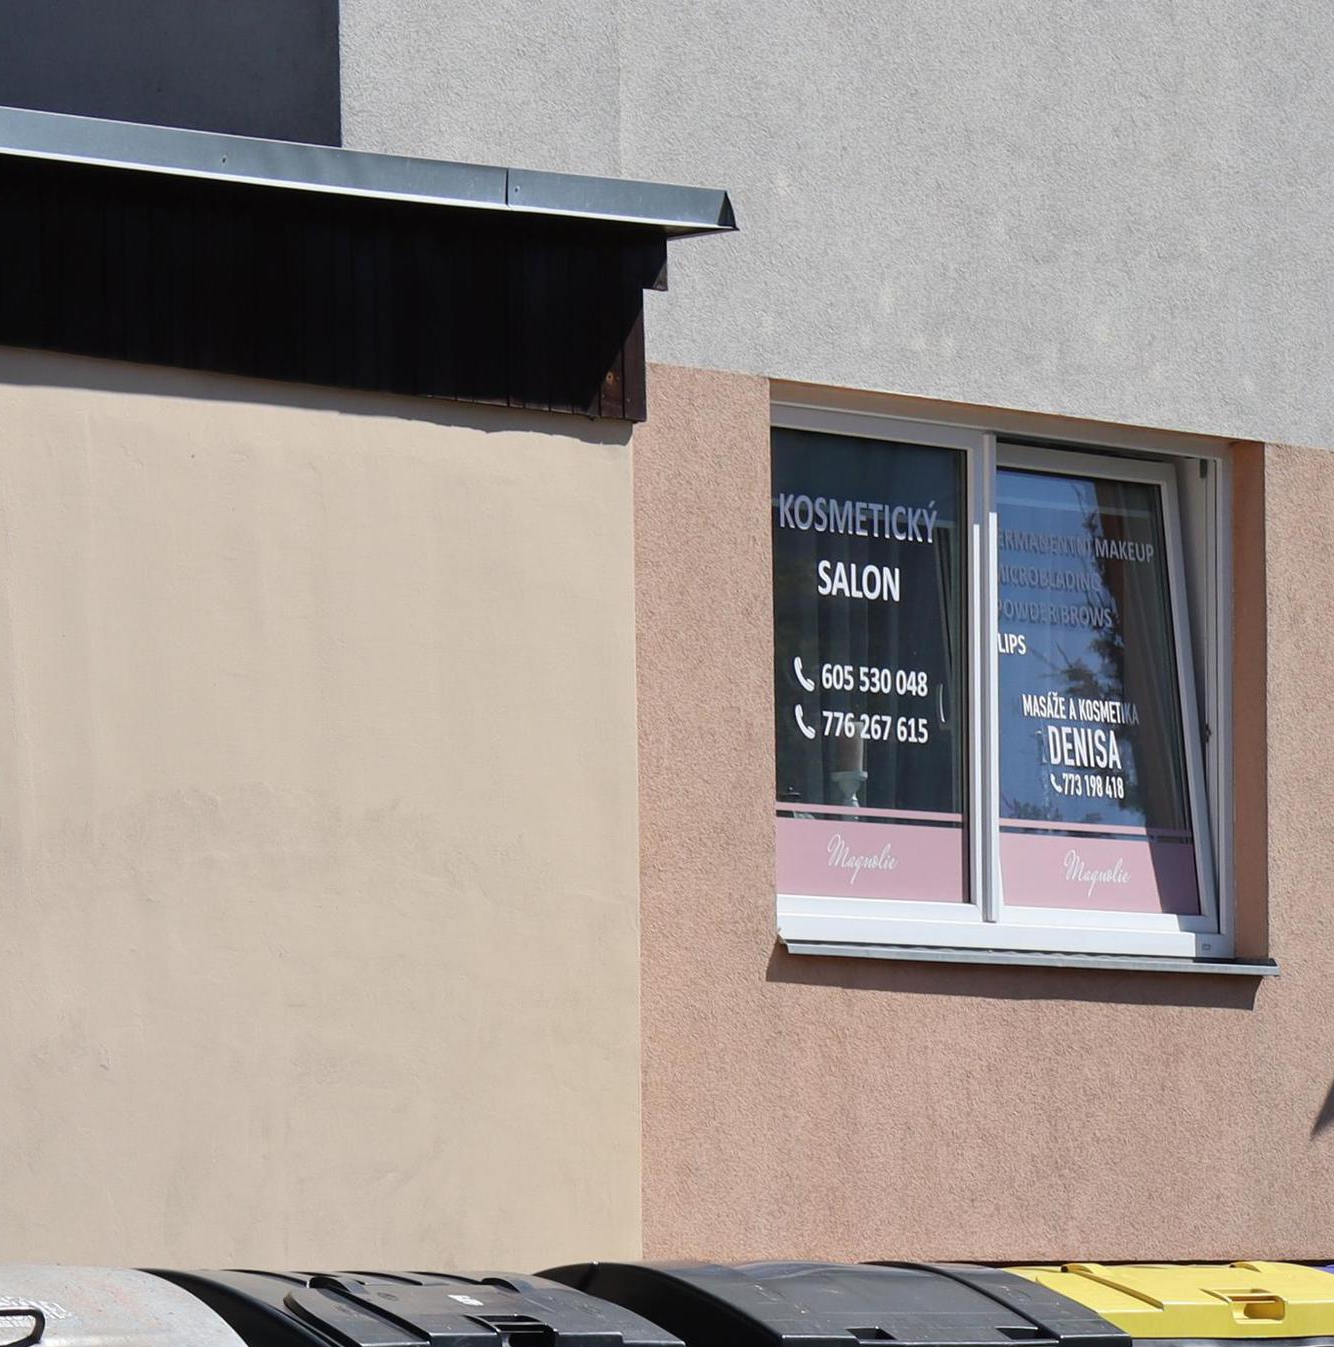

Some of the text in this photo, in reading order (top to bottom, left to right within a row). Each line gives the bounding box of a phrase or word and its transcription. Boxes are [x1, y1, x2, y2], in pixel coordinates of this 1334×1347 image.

[778, 492, 937, 544] KOSMETICKÝ
[1094, 538, 1154, 563] MAKEUP
[817, 559, 900, 602] SALON
[998, 633, 1027, 655] LIPS
[821, 663, 928, 697] 605 530 048
[1022, 691, 1140, 725] MASÁŽE A KOSMETIKA
[822, 710, 928, 744] 776 267 615
[1047, 724, 1122, 770] DENISA
[1062, 773, 1125, 799] 773 198 418
